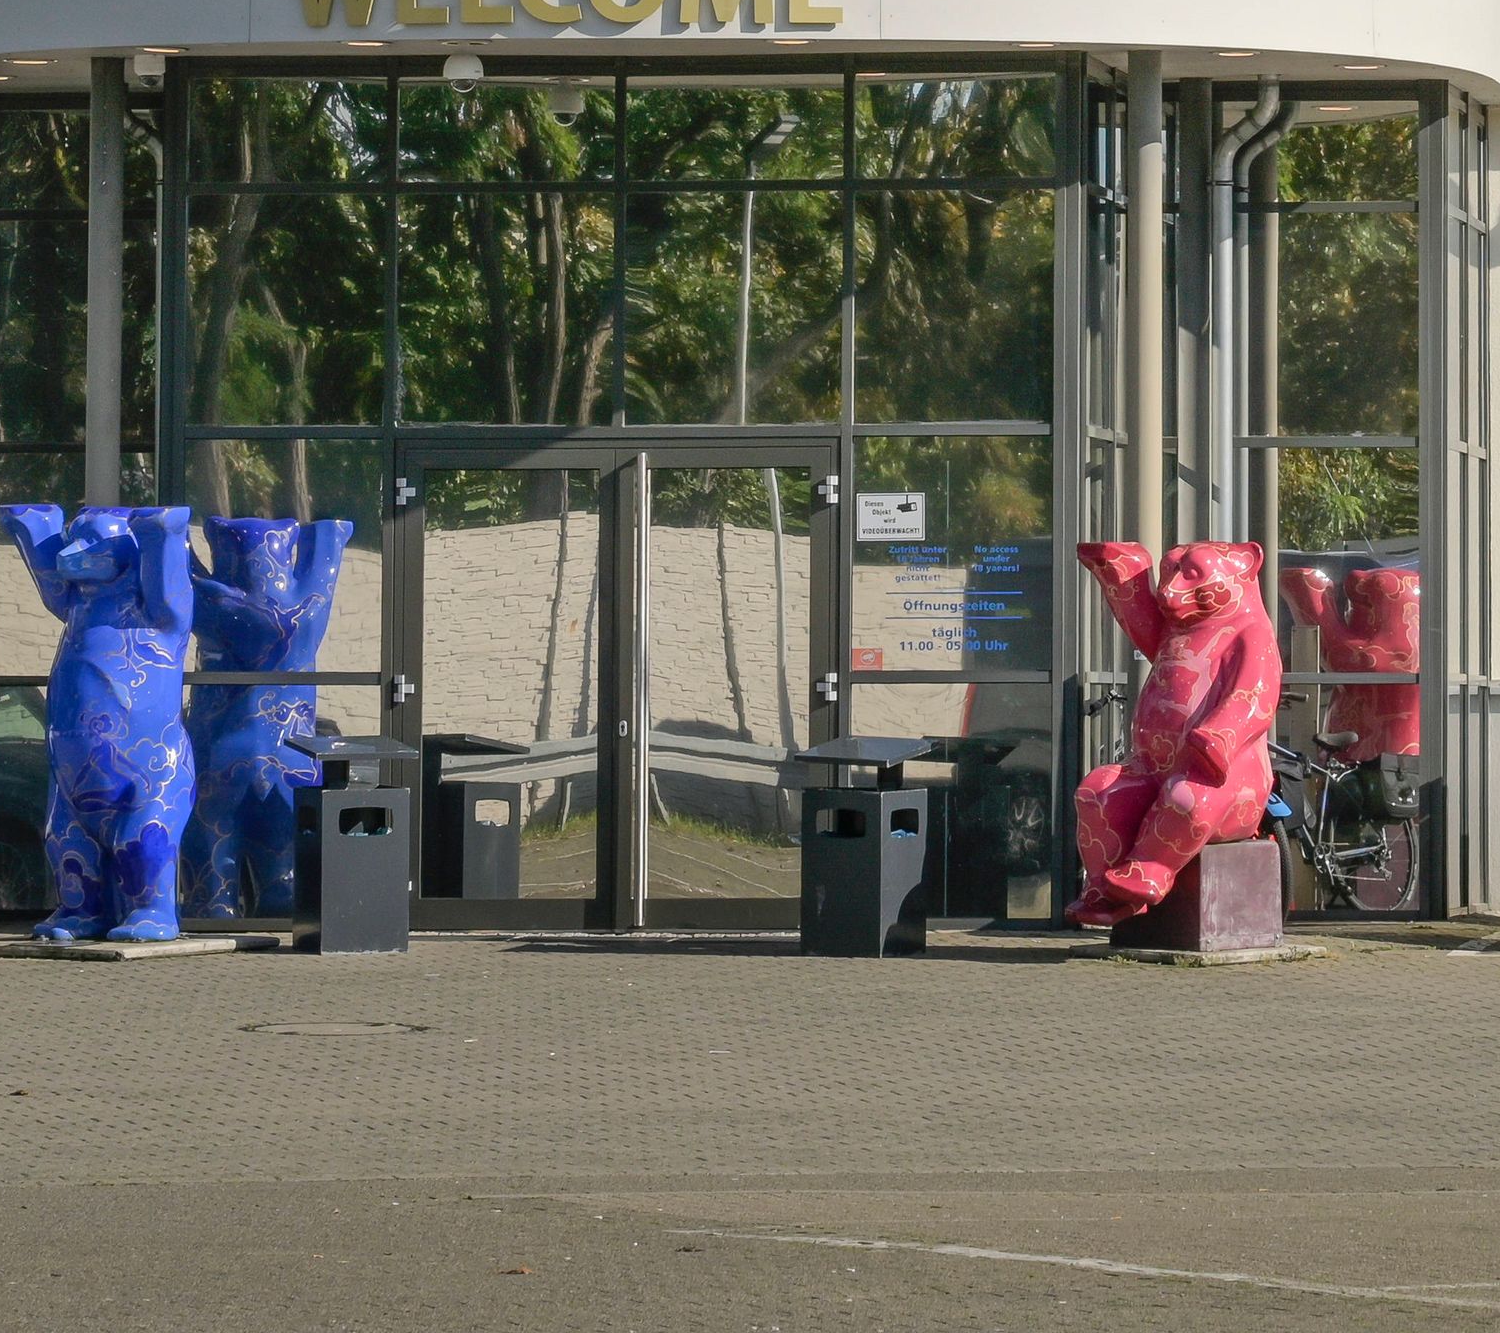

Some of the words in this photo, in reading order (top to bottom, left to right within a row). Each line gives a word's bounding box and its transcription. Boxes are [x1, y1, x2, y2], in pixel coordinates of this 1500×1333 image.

[889, 545, 921, 553] Zutritt
[922, 545, 947, 553] unter
[974, 545, 987, 553] No
[990, 545, 1019, 553] access
[983, 555, 1010, 563] under
[895, 574, 941, 583] gestattet!
[903, 599, 1005, 613] Öffnungszeiten
[932, 627, 977, 639] täglich
[900, 641, 933, 651] 11.00
[946, 641, 981, 651] 0500
[985, 640, 1009, 651] Uhr
